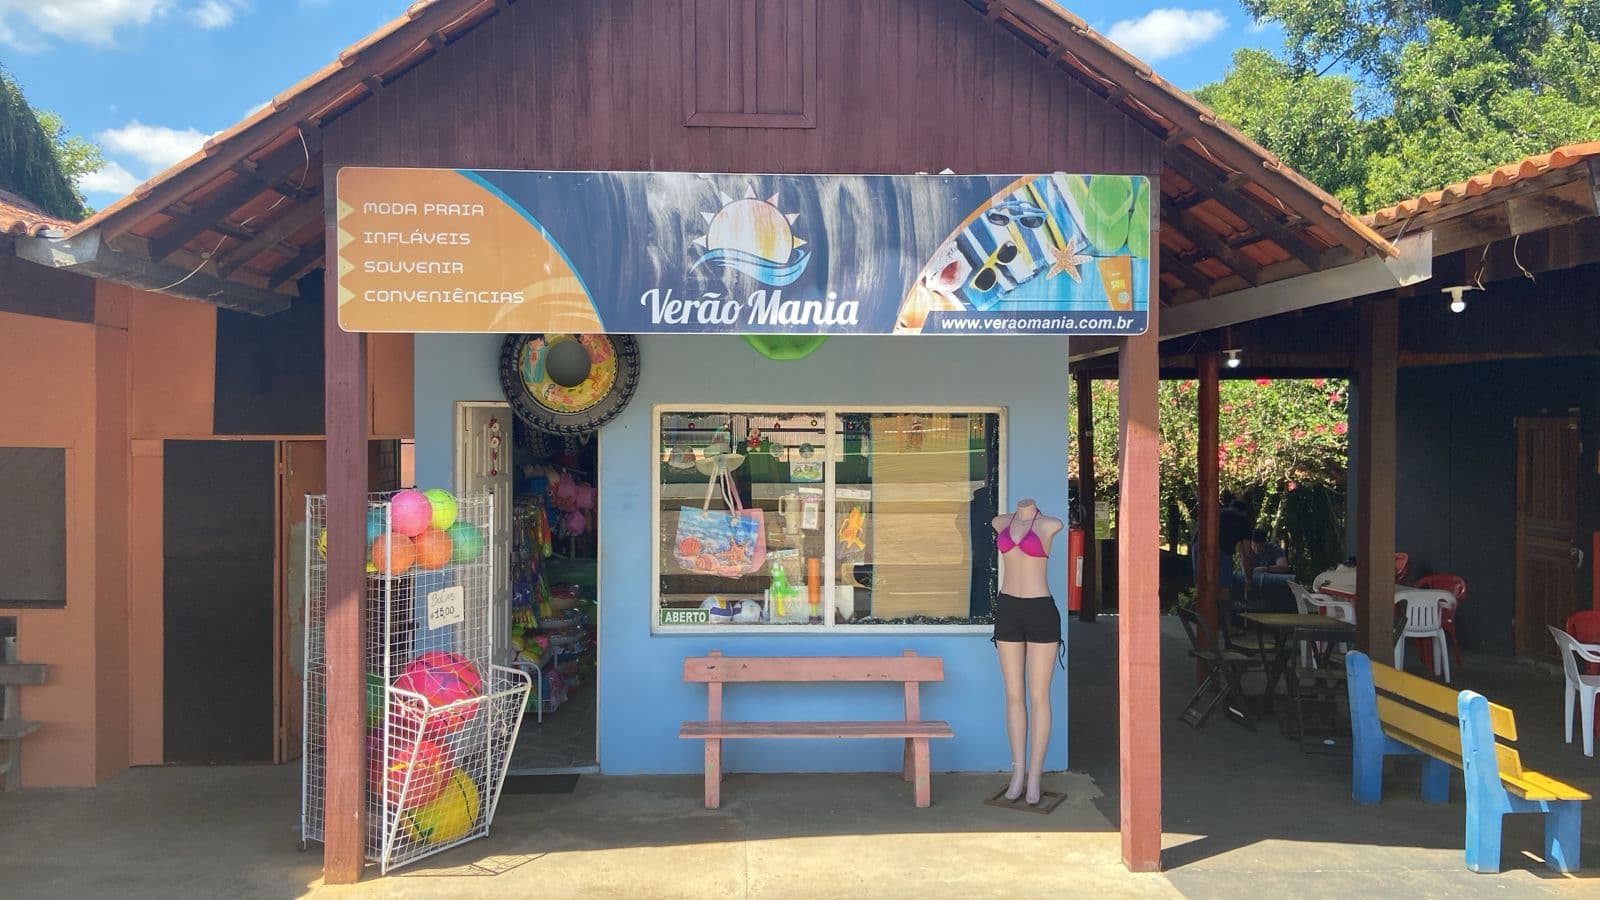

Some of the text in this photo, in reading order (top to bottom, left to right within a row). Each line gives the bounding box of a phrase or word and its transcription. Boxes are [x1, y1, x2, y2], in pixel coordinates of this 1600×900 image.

[363, 202, 485, 217] MODA PRAIA
[363, 229, 471, 245] INFLÁVEIS
[364, 261, 464, 274] SOUVENIR
[364, 288, 525, 304] CONVENIÊNCIAS
[640, 288, 860, 326] Verão Mania
[941, 316, 1134, 330] www.veraomania.com.br
[665, 611, 707, 623] ABERTO
